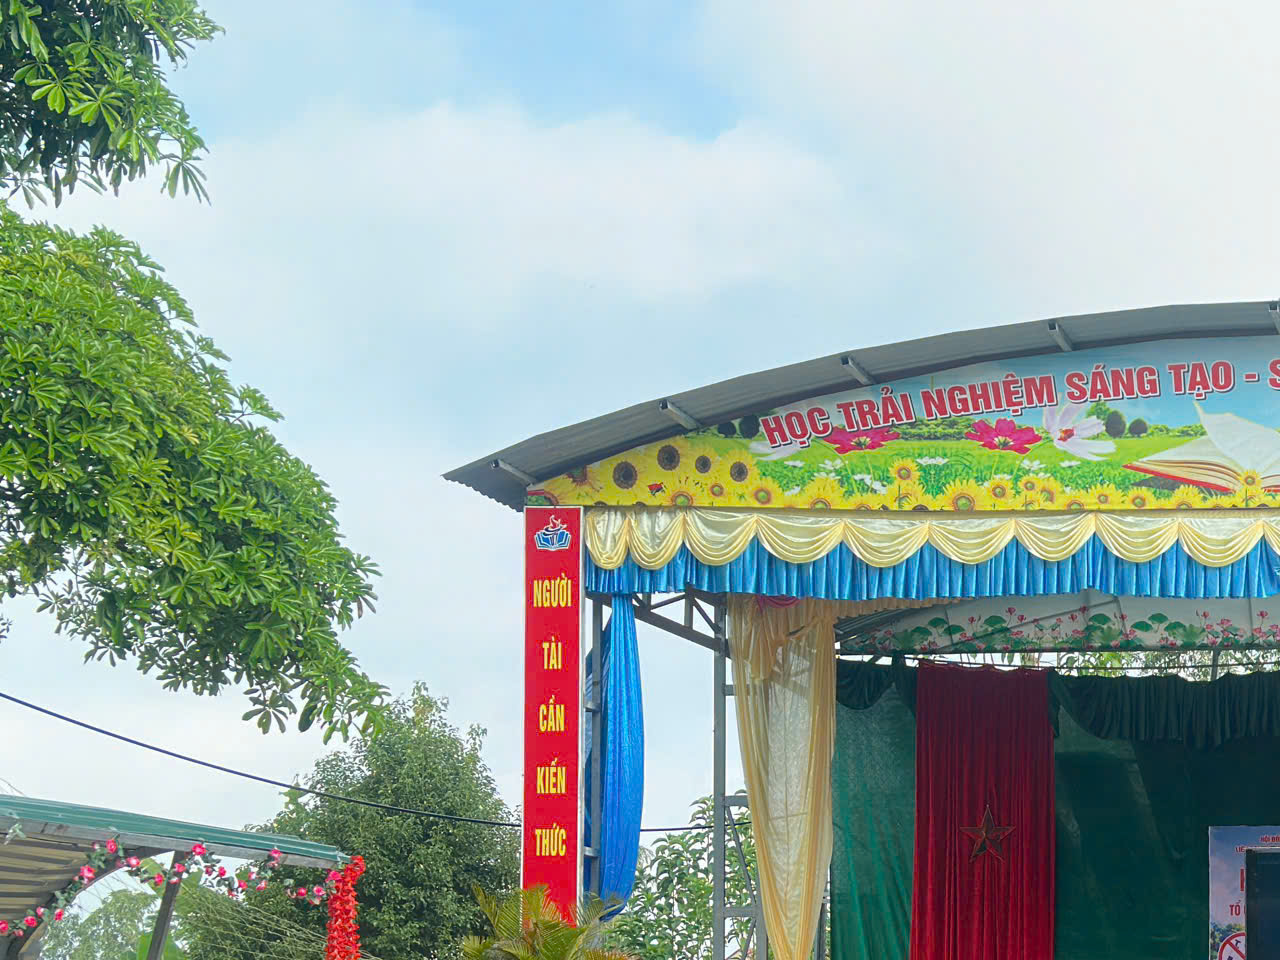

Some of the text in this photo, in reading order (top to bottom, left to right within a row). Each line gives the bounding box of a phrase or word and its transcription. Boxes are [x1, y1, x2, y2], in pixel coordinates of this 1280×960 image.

[760, 408, 832, 447] HỌC
[836, 384, 914, 431] TRẢI
[921, 373, 1056, 417] NGHIỆM
[1065, 355, 1159, 402] SÁNG
[1167, 360, 1234, 399] TẠO
[533, 573, 573, 608] NGƯỜI
[542, 637, 562, 670] TÀI
[536, 758, 566, 794] KIẾN
[534, 823, 567, 857] THỨC
